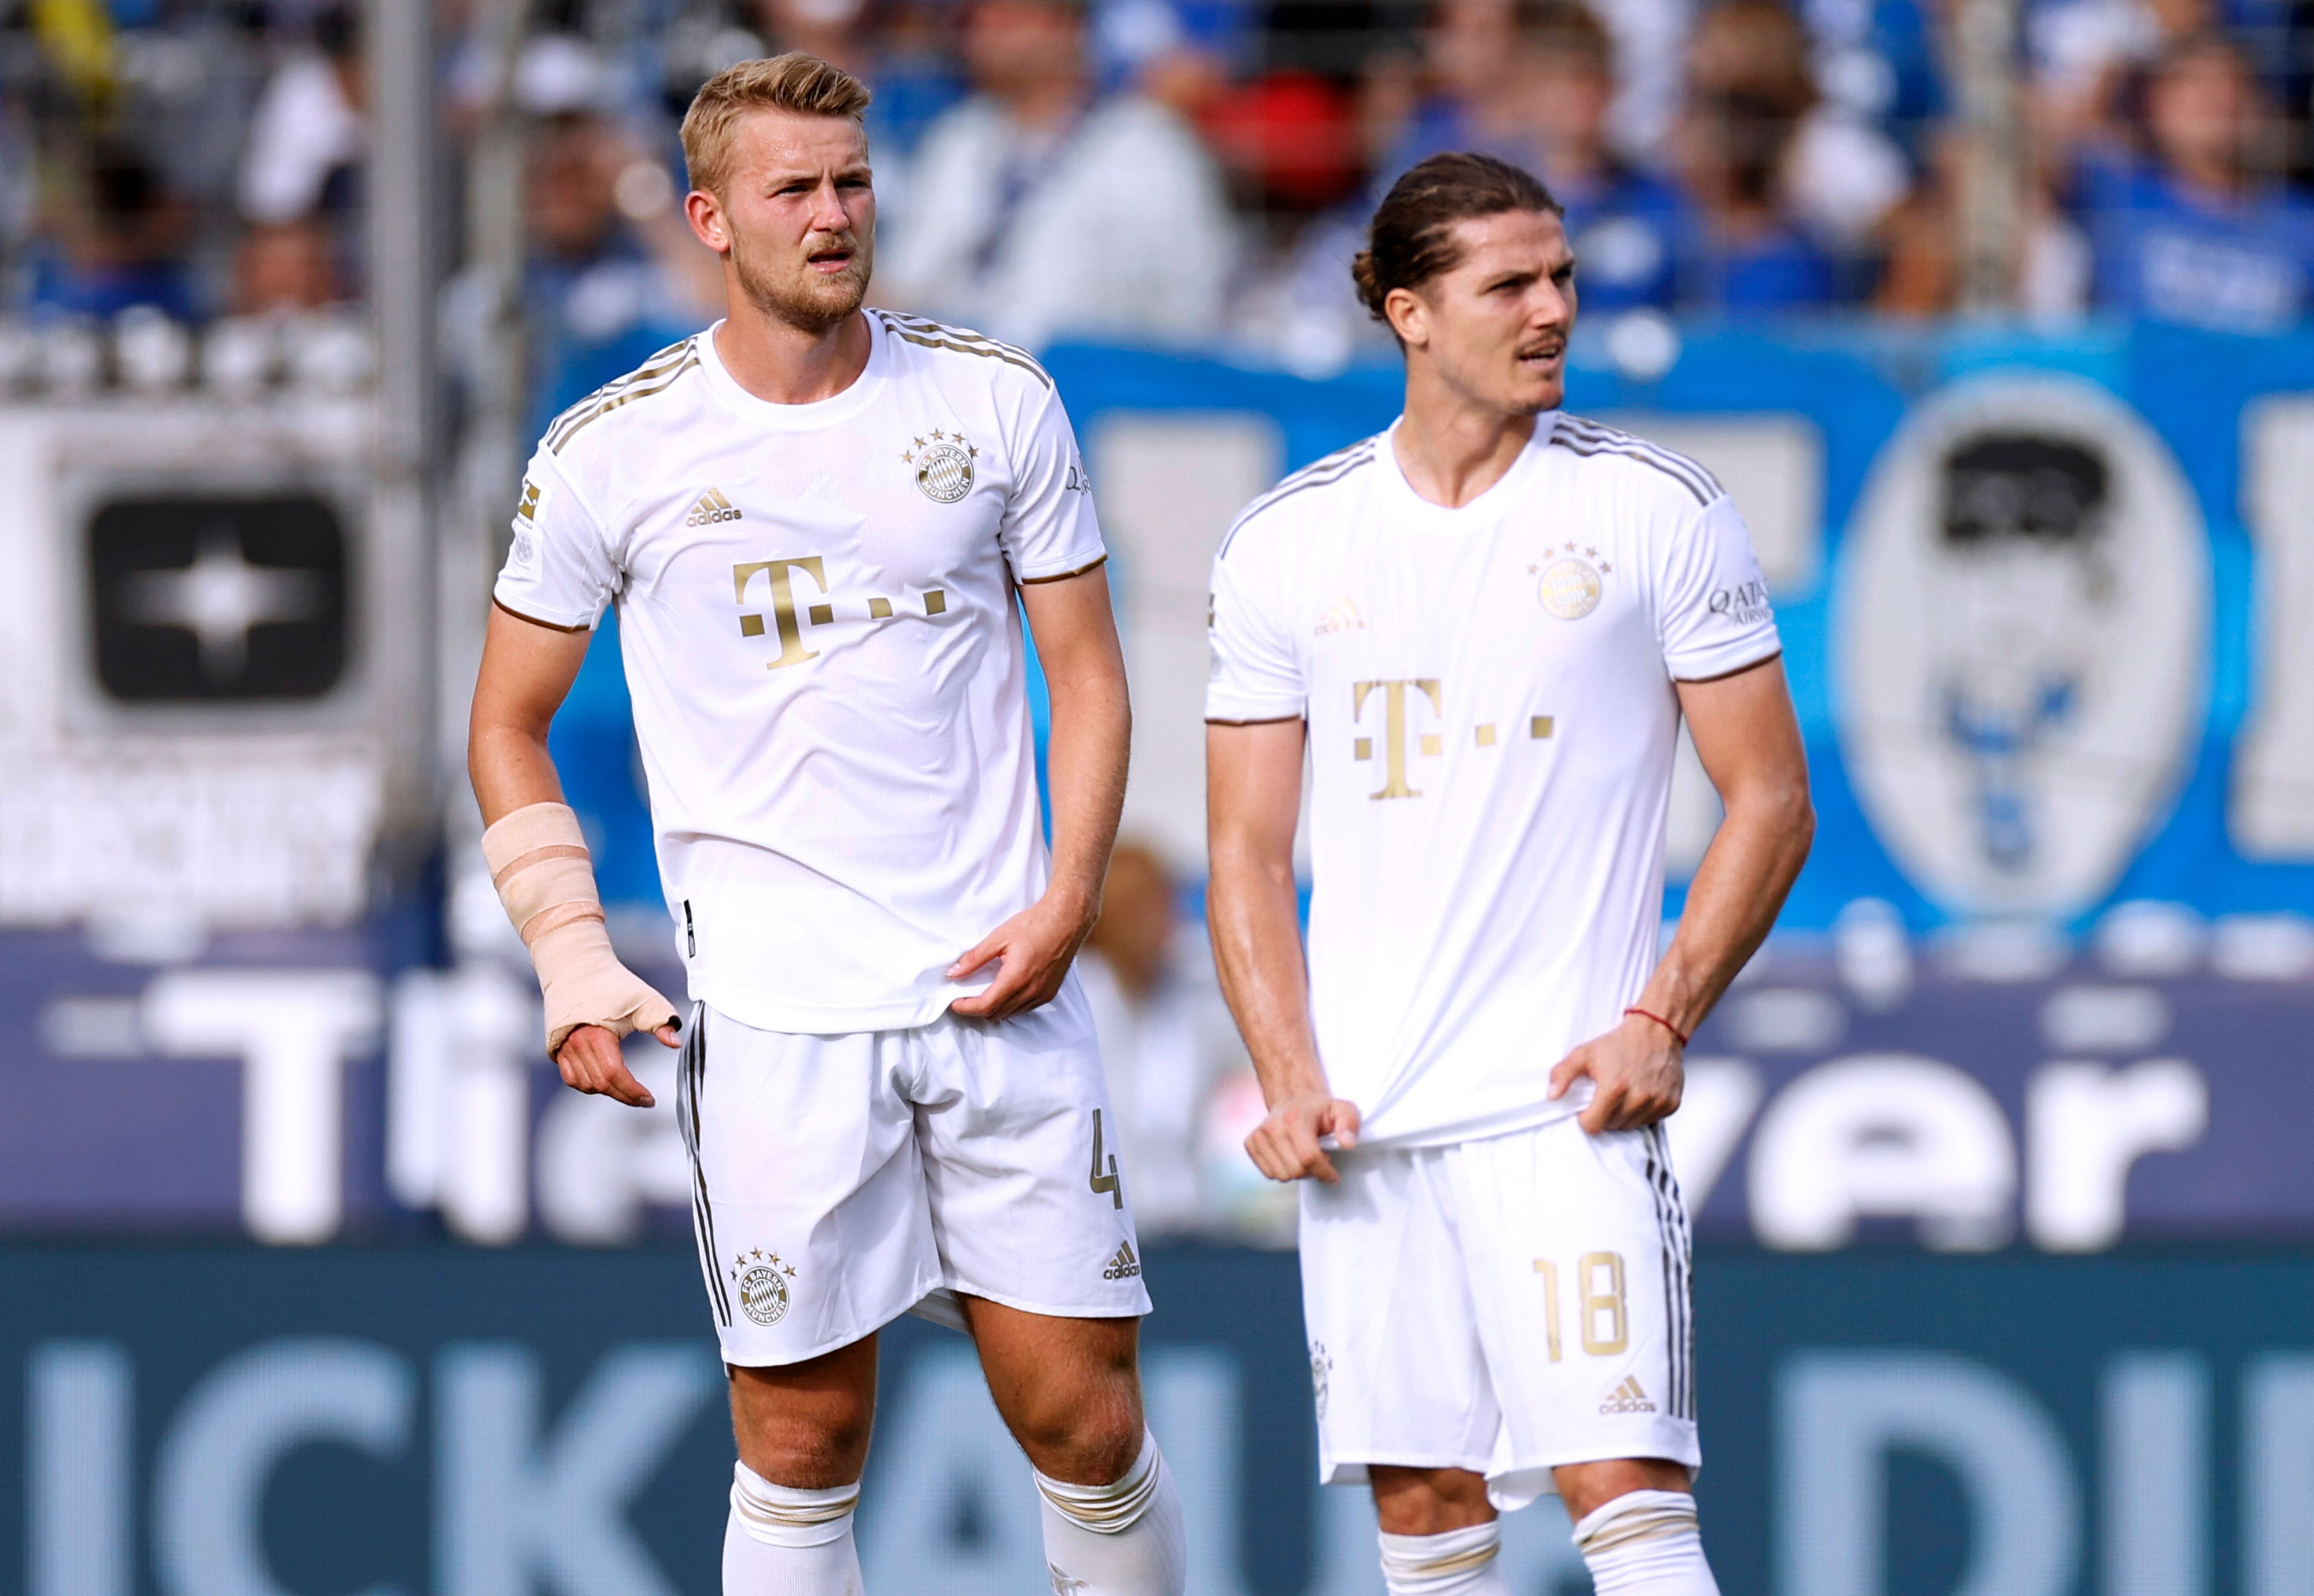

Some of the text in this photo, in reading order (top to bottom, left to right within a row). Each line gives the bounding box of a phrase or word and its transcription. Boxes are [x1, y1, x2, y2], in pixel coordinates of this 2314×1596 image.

[920, 448, 968, 471] FC BAYERN
[686, 509, 742, 527] adidas
[1708, 578, 1768, 615] QATA
[1090, 1108, 1123, 1210] 4
[742, 1270, 783, 1293] FC BAYERN
[1103, 1263, 1140, 1280] adidas
[1532, 1251, 1628, 1363] 18
[1600, 1399, 1656, 1414] adidas
